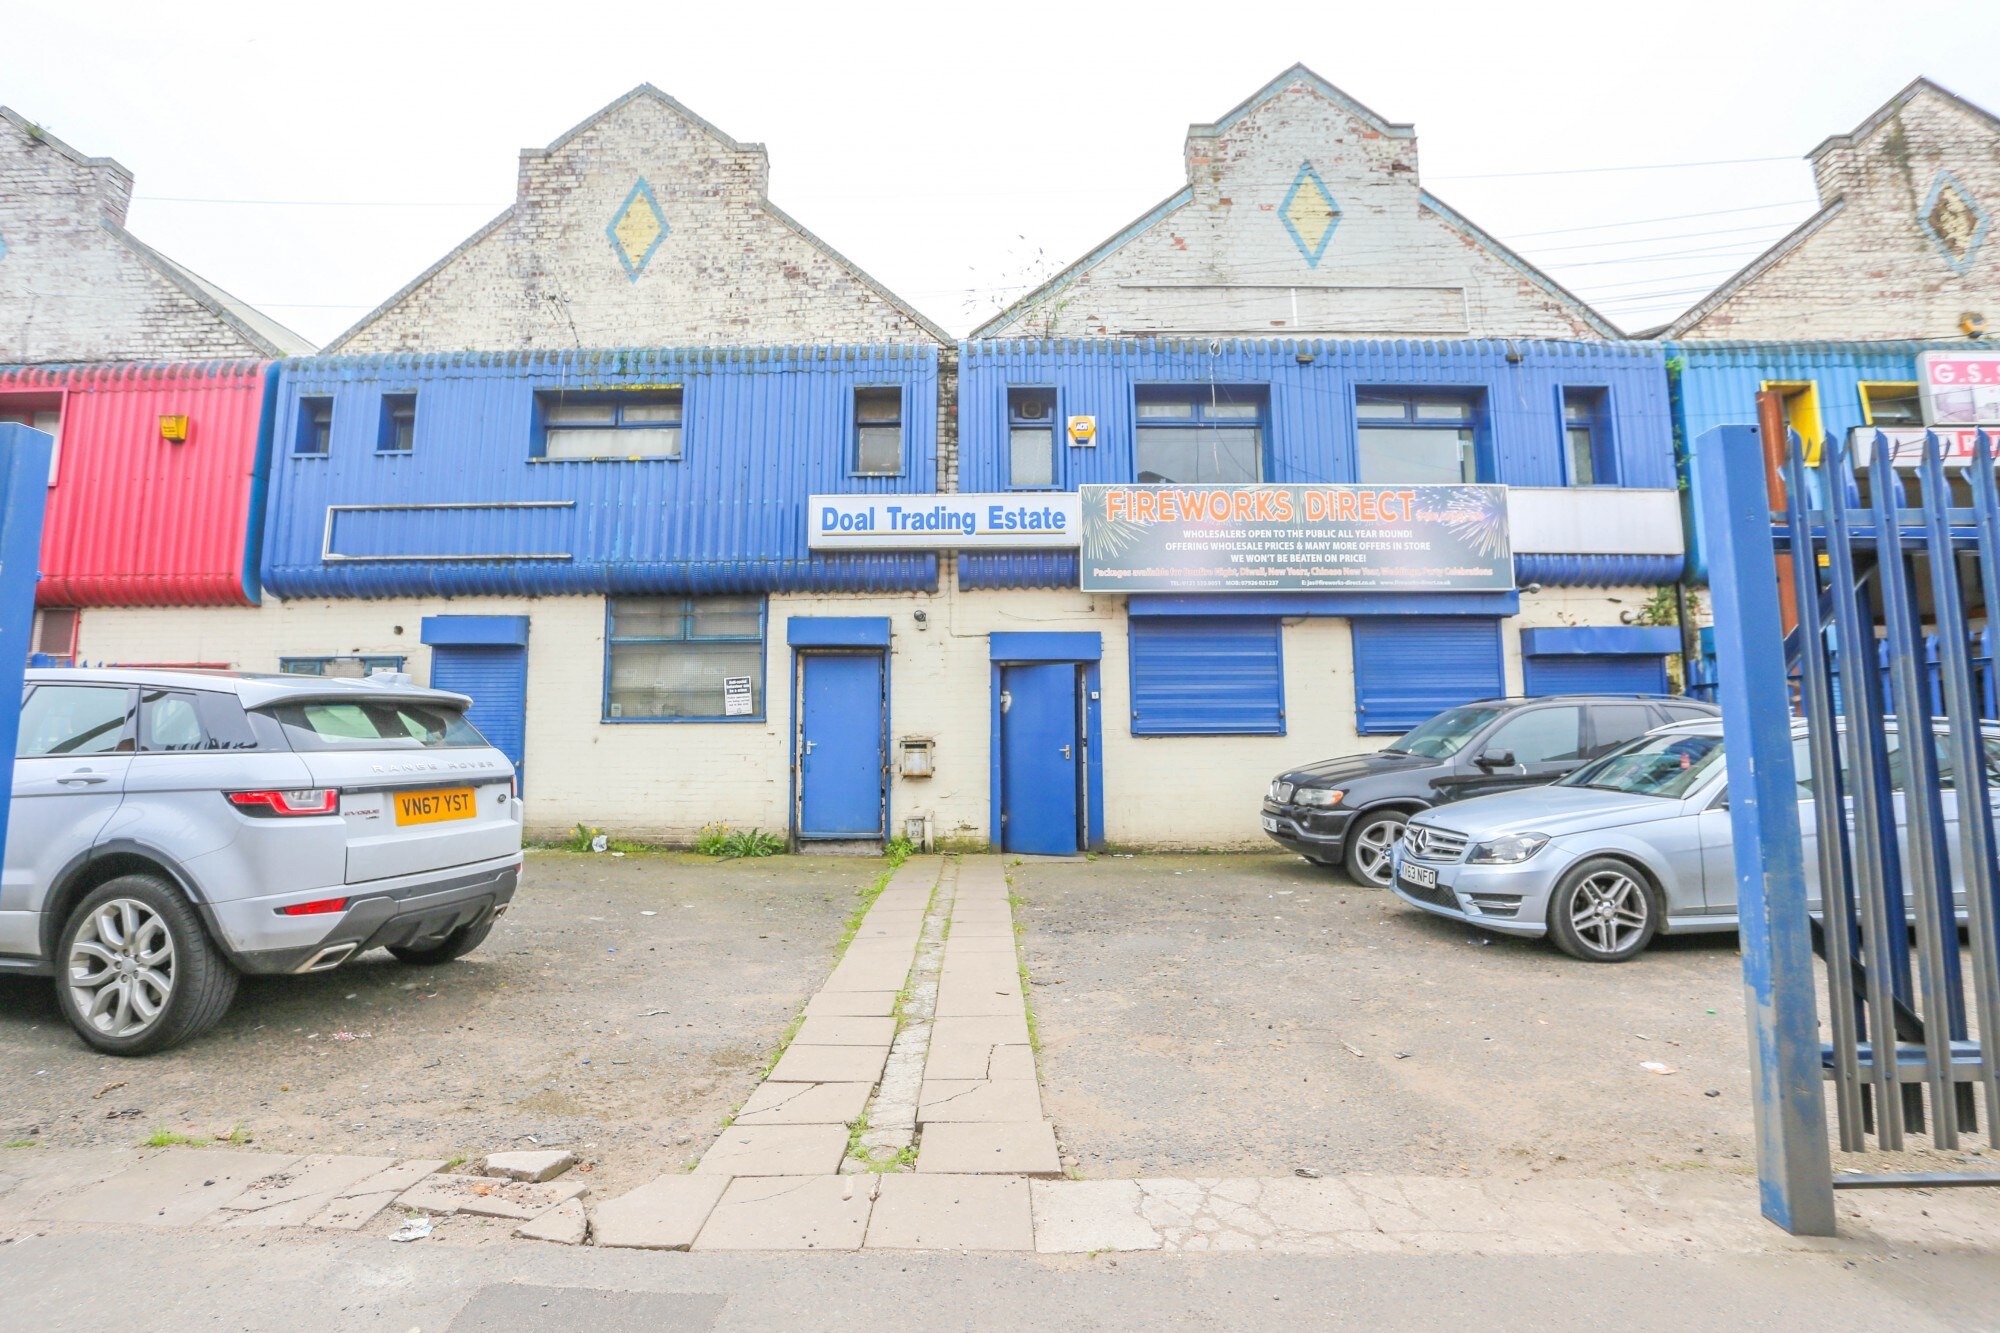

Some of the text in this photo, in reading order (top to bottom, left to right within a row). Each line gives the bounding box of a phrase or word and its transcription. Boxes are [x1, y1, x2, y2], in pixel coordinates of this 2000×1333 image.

[1934, 363, 2000, 383] G.S.
[1106, 490, 1415, 522] FIREWORKS DIRECT
[822, 505, 1066, 535] Doal Trading Estate
[1183, 530, 1412, 538] WHOLESALERS OPEN TO THE PUBLIC ALL YEAR ROUND!
[1165, 542, 1431, 551] OFFERING WHOLESALE PRICES & MANY MORE OFFERS IN STORE
[1231, 554, 1366, 563] WE WON'T BE BEATEN ON PRICE!
[1093, 568, 1131, 578] Packages
[1268, 567, 1286, 576] New
[1310, 567, 1342, 576] Chinese
[1343, 567, 1360, 576] New
[1444, 566, 1493, 576] Celebrations
[371, 763, 438, 773] RANGE
[402, 793, 469, 817] VN67 YST
